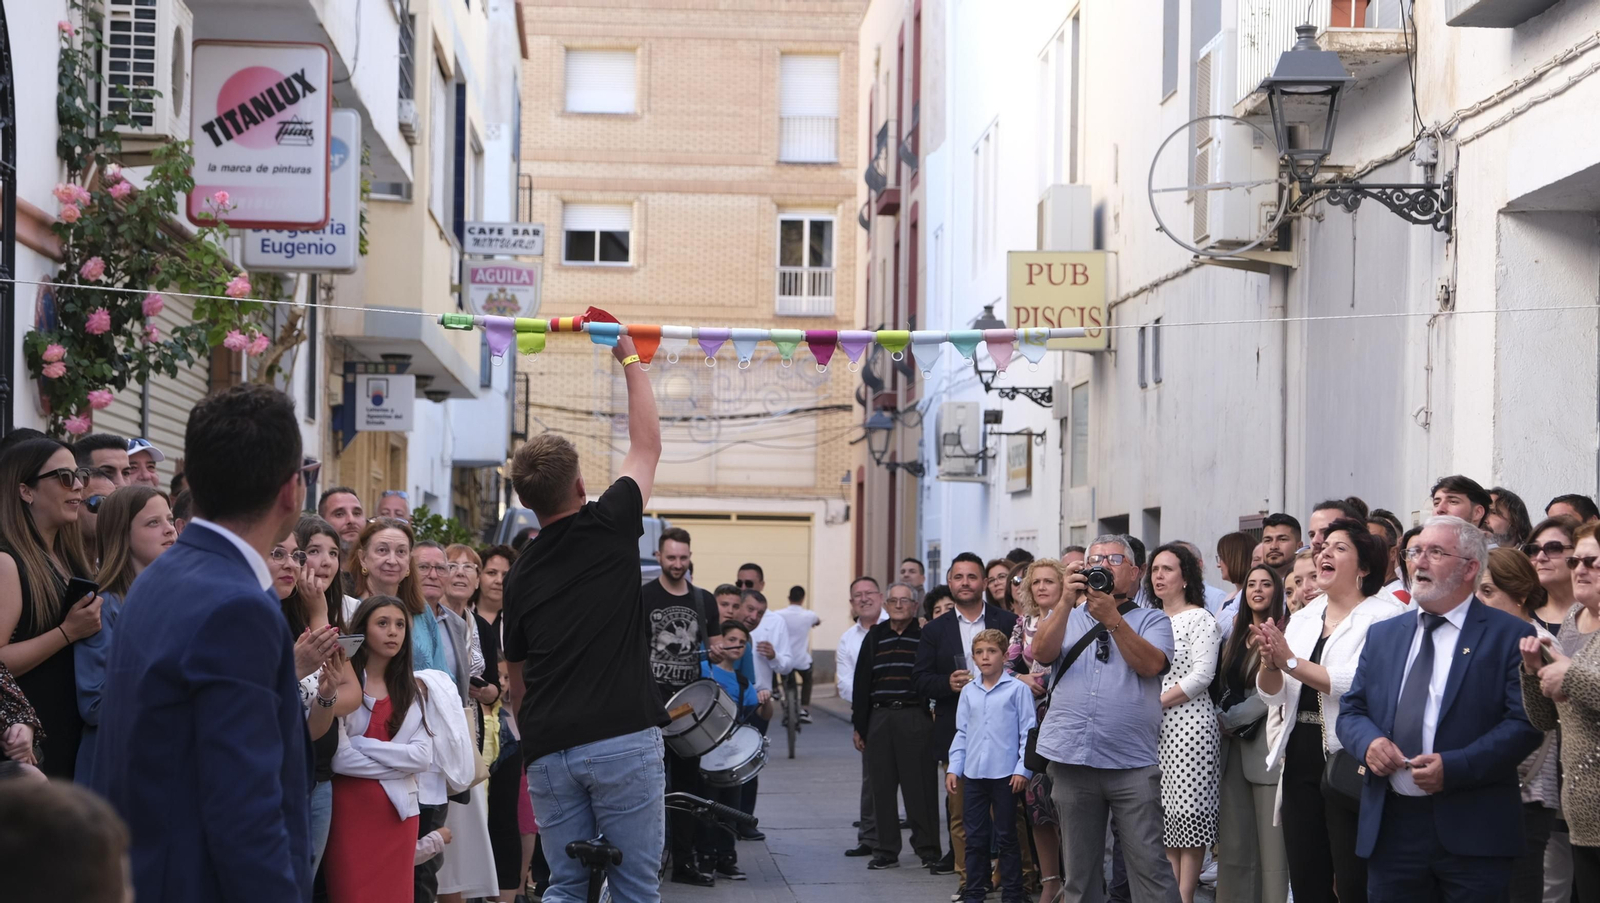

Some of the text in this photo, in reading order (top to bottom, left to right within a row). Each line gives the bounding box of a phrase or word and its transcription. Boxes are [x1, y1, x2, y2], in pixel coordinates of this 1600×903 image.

[201, 68, 317, 147] TITANLUX
[208, 163, 312, 175] la marca de pinturas
[512, 228, 540, 236] BAR
[260, 238, 336, 259] Eugenio
[475, 268, 530, 284] AGUILA
[1025, 263, 1089, 286] PUB
[1013, 306, 1102, 338] PISCIS
